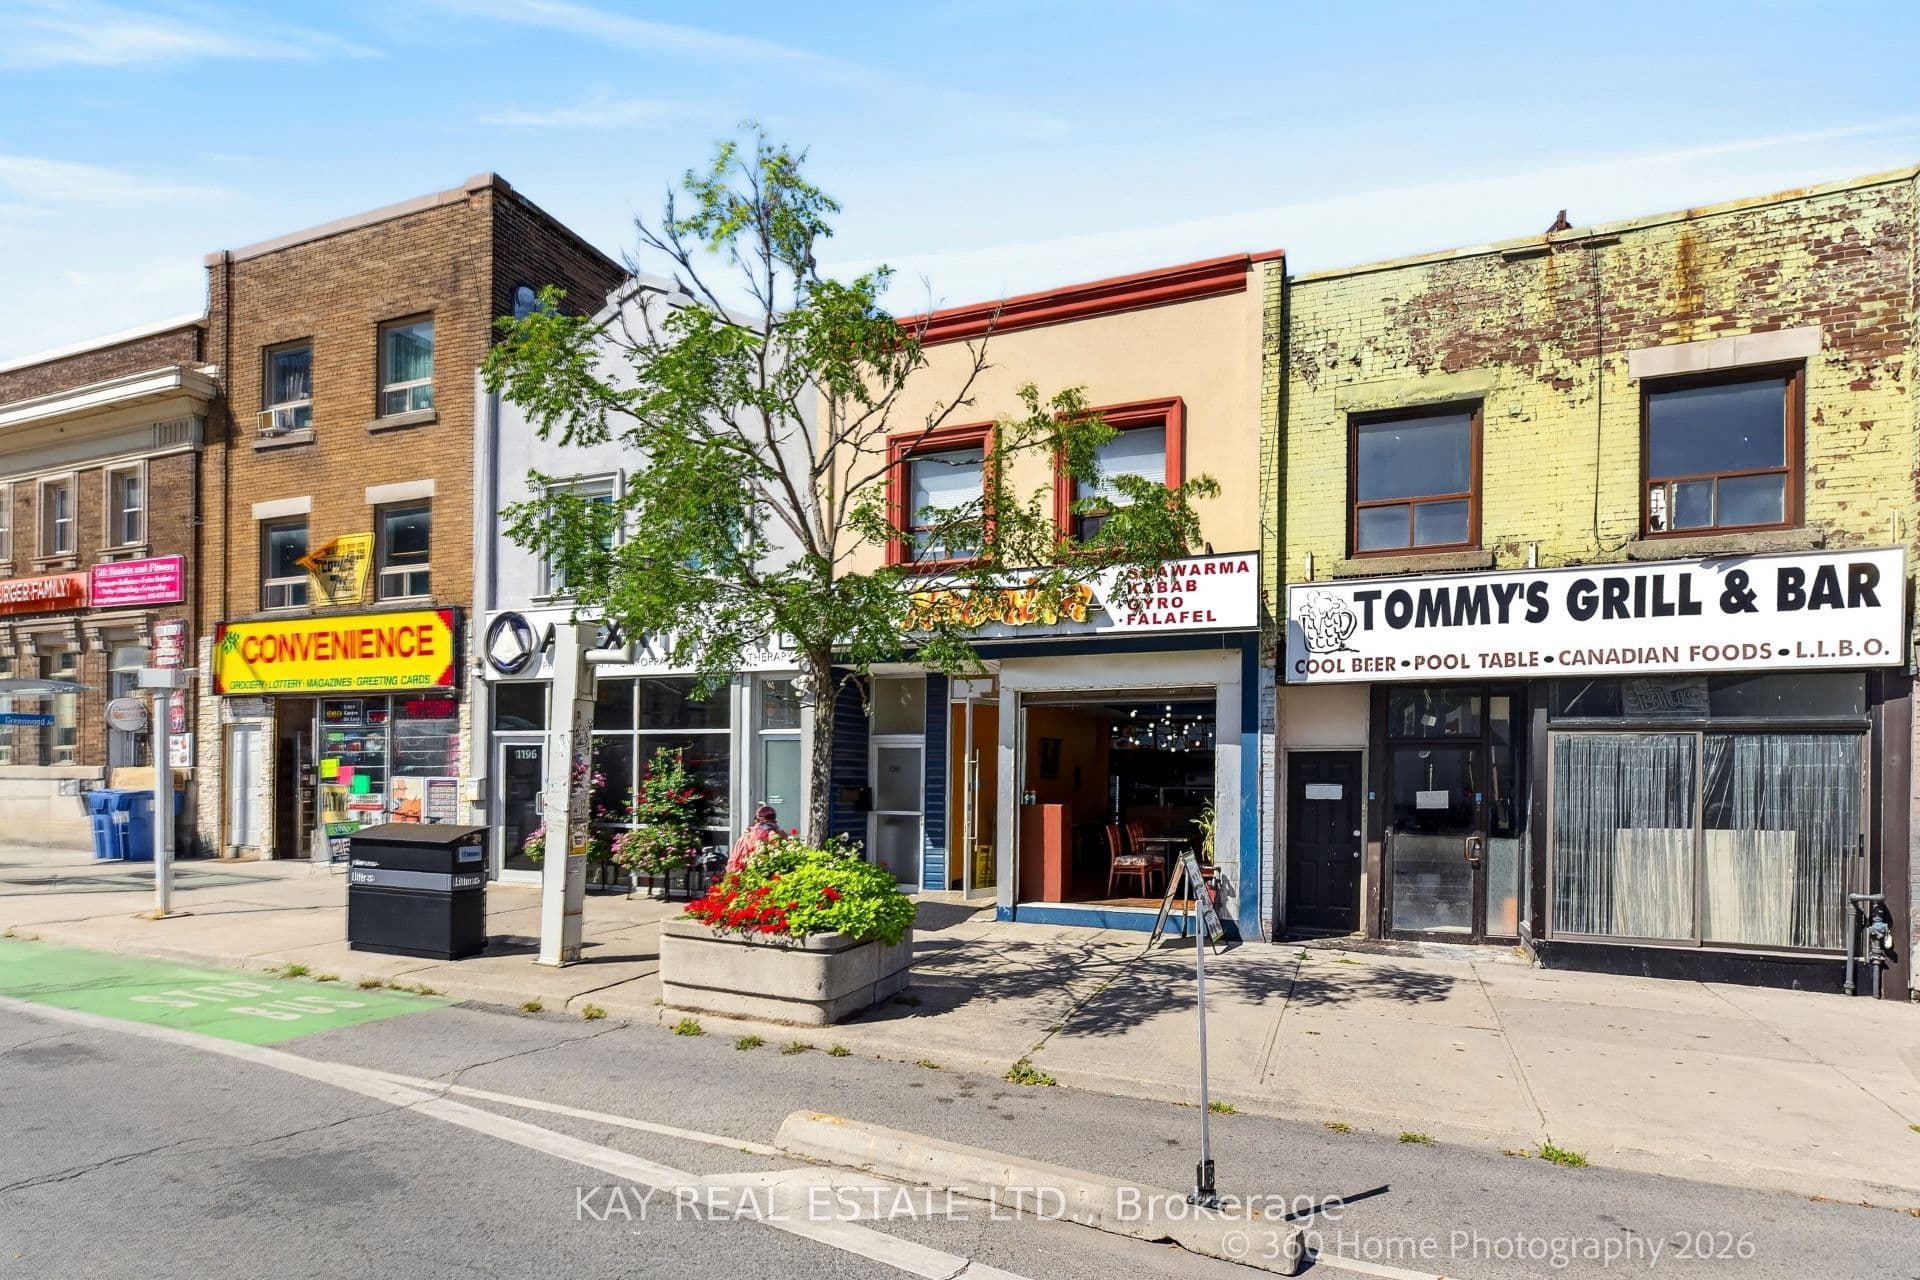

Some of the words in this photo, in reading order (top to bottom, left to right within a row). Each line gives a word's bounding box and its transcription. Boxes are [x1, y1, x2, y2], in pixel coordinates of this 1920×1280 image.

[1127, 580, 1197, 595] KABAB
[1127, 597, 1183, 610] GYRO
[1354, 580, 1549, 630] TOMMY'S
[1566, 573, 1702, 622] GRILL
[1719, 569, 1759, 614] &
[1777, 562, 1881, 611] BAR
[1127, 610, 1216, 625] FALAFEL
[241, 625, 434, 664] CONVENIENCE
[748, 652, 793, 662] THERAPY
[1295, 658, 1345, 674] COOL
[1351, 656, 1396, 673] BEER
[1414, 654, 1470, 670] POOL
[1478, 651, 1538, 668] TABLE
[1558, 646, 1679, 666] CANADIAN
[1689, 642, 1772, 662] FOODS
[1796, 638, 1890, 658] L.L.B.O.
[230, 680, 265, 689] GROCERY
[268, 679, 301, 688] LOTTERY
[306, 678, 352, 688] MAGAZINES
[356, 675, 398, 686] GREETING
[401, 674, 431, 685] CARDS
[515, 749, 537, 759] 1196
